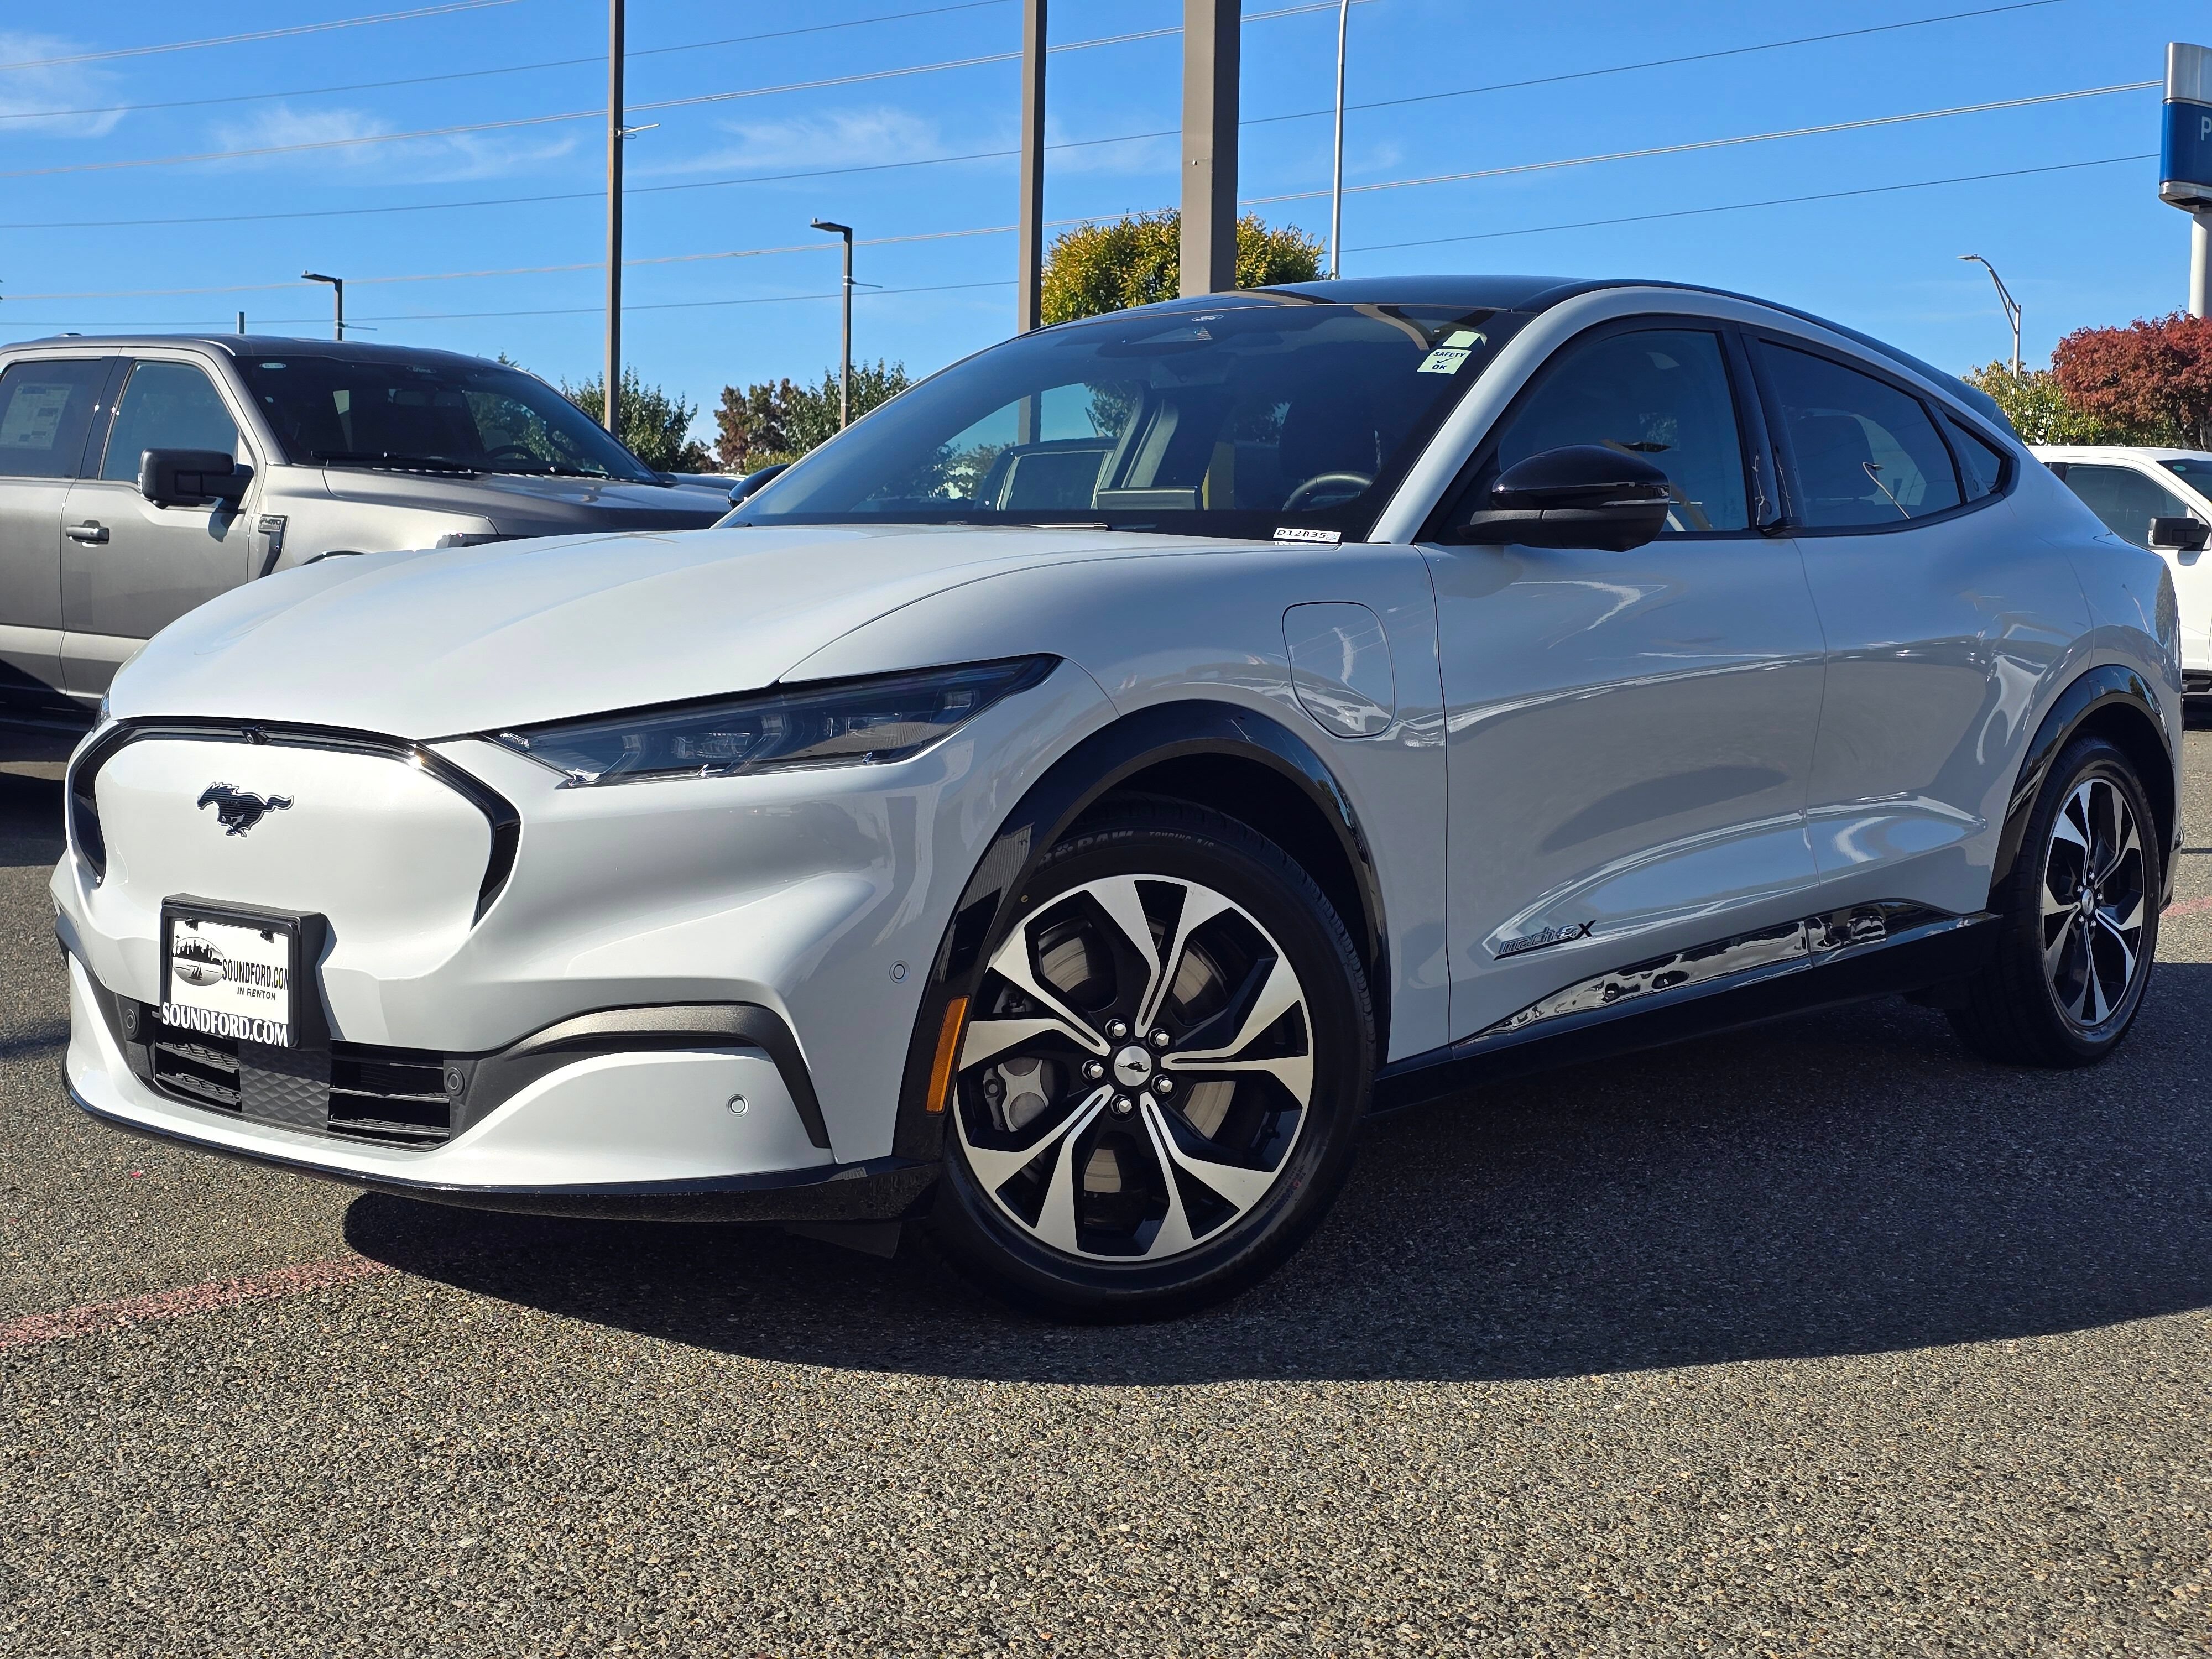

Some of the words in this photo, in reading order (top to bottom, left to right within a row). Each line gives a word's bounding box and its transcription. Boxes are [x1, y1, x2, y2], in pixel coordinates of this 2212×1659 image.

[2201, 116, 2212, 141] P
[237, 986, 244, 995] IN
[247, 988, 276, 1000] RENTON
[161, 1001, 288, 1047] SOUNDFORD.COM
